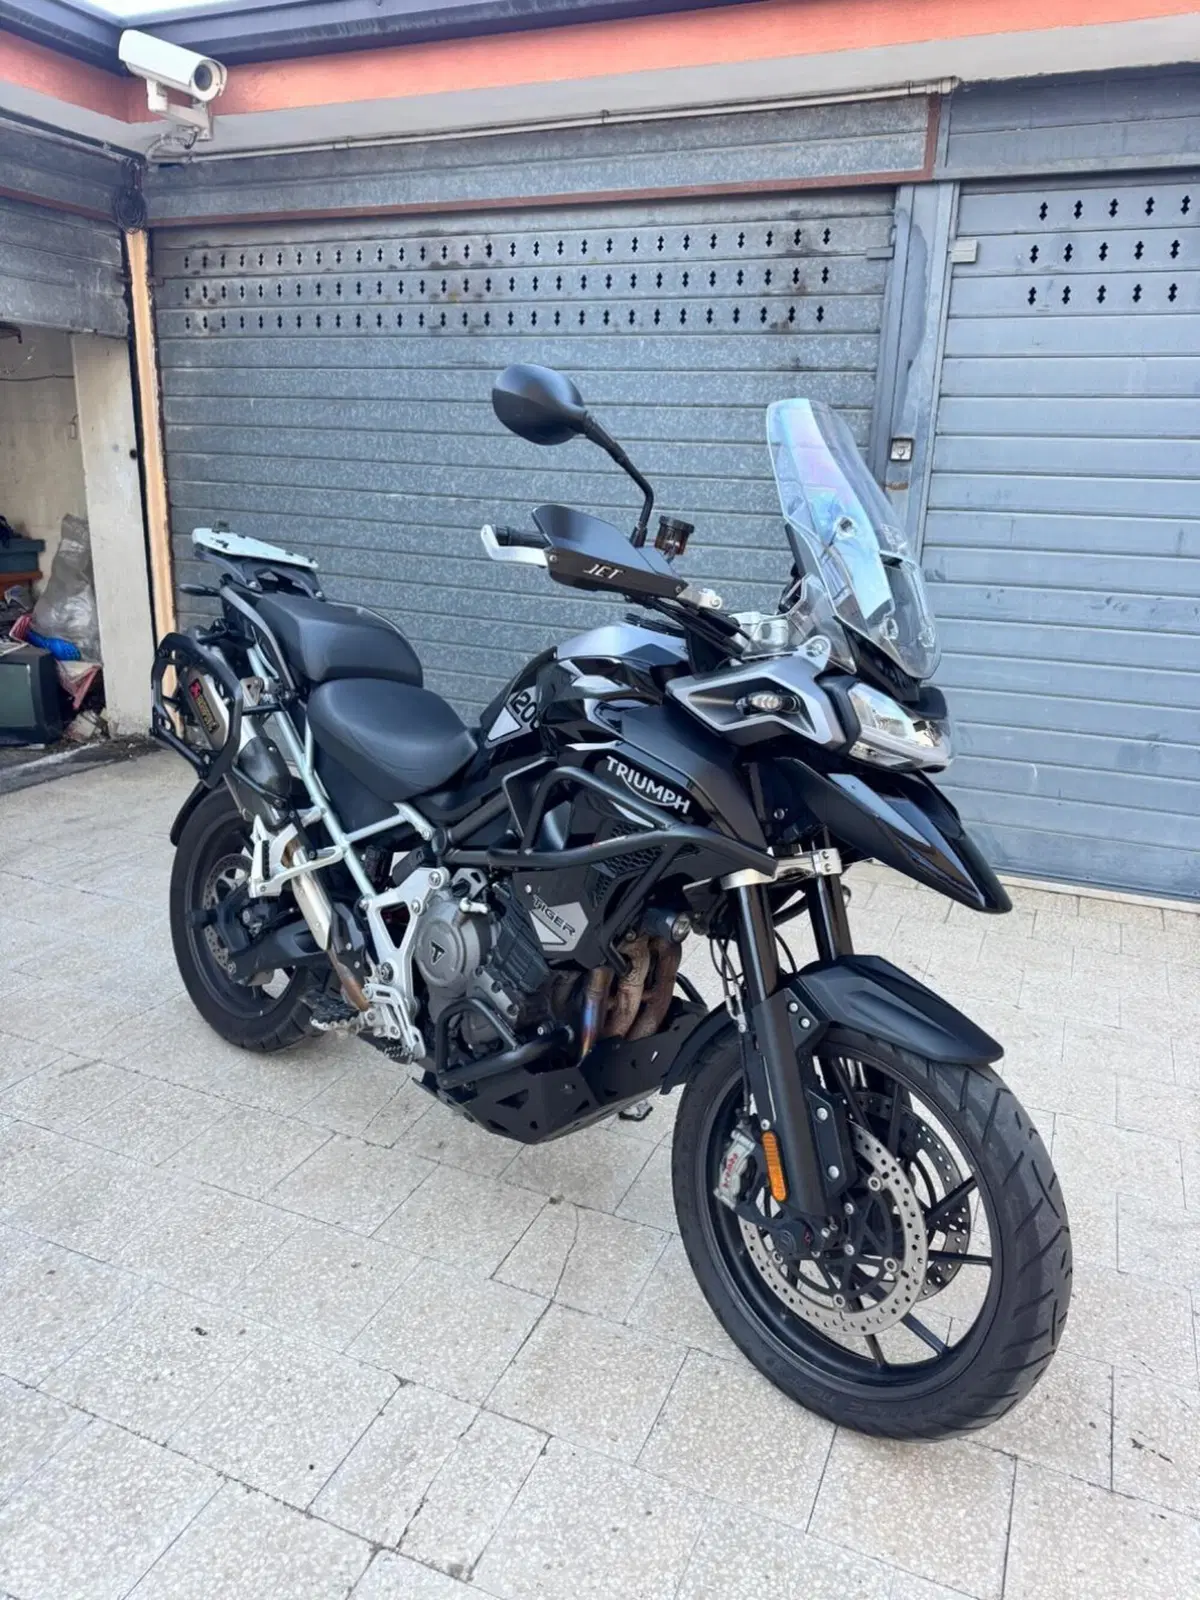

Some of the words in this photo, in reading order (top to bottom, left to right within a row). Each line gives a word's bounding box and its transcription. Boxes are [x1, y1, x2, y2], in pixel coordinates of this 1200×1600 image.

[582, 564, 625, 579] JET
[606, 755, 691, 814] TRIUMPH
[533, 894, 576, 936] TIGER
